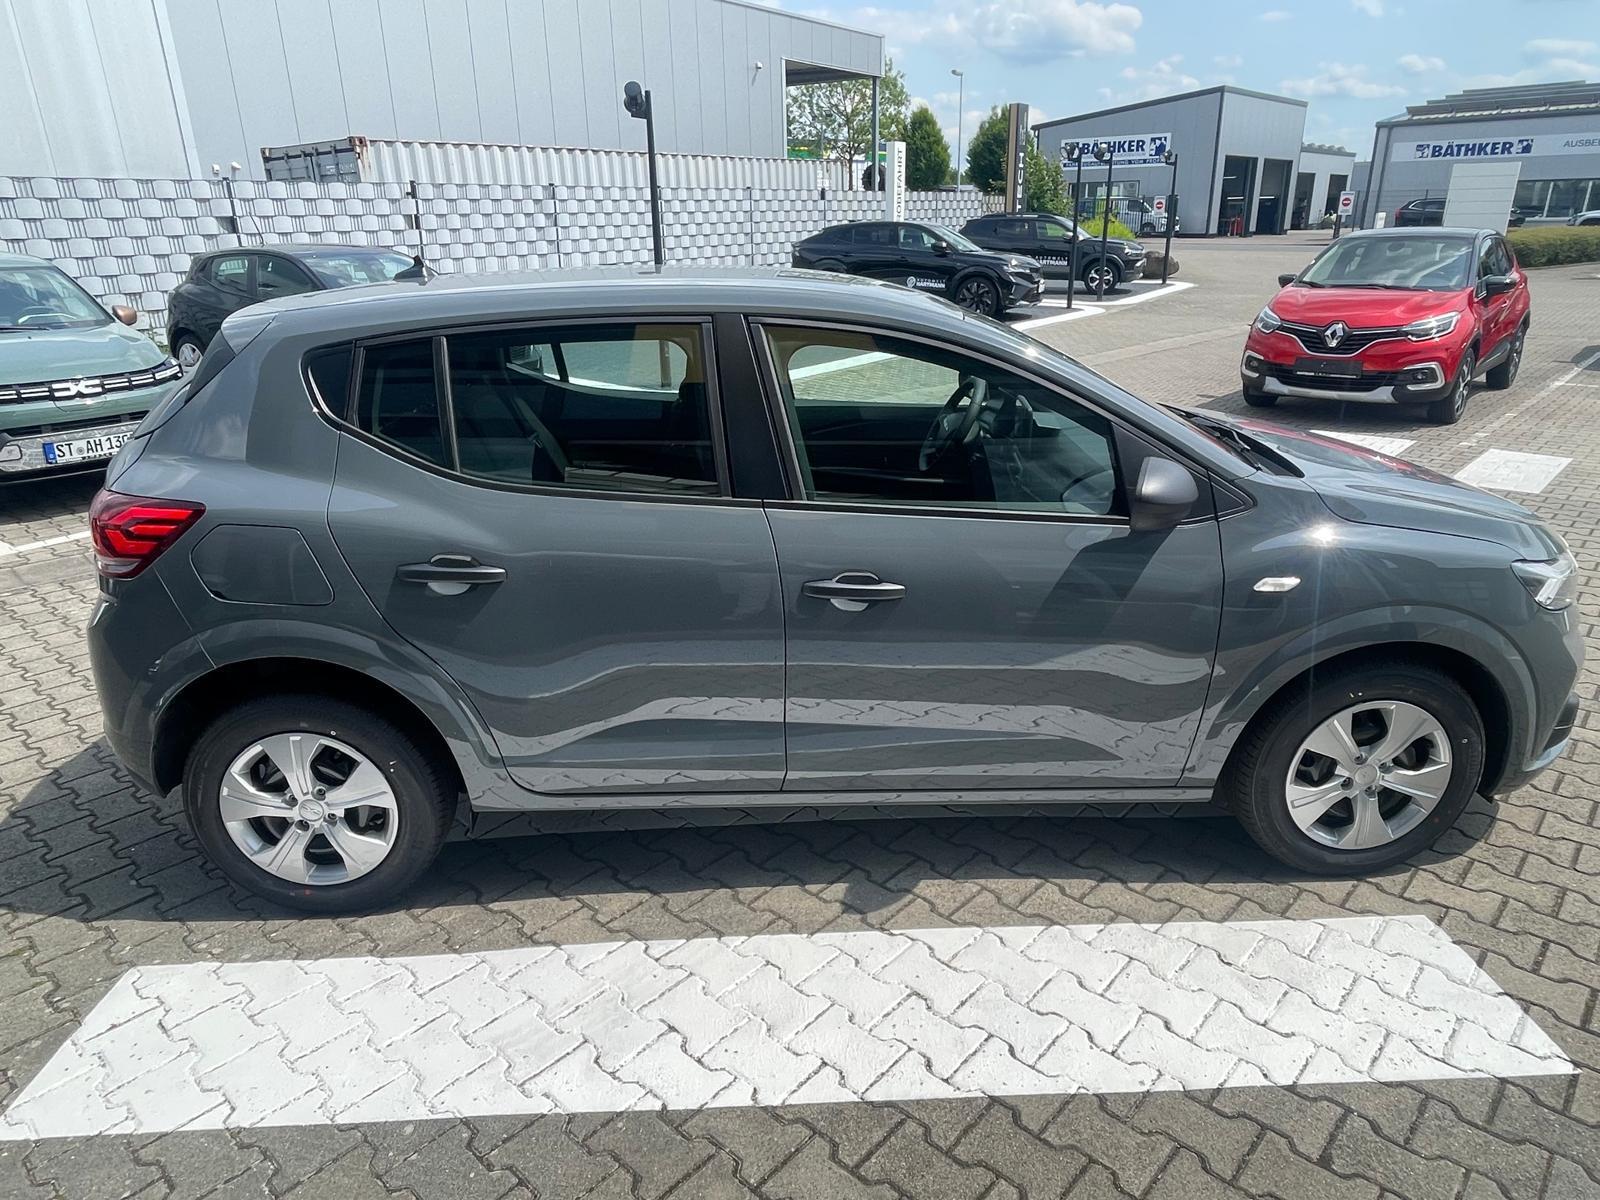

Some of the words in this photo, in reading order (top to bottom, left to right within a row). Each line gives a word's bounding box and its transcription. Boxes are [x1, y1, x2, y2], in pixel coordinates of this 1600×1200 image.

[1431, 142, 1514, 158] BÄTHKER
[1563, 138, 1600, 148] AUSBE
[56, 442, 74, 458] ST
[86, 439, 104, 454] AH
